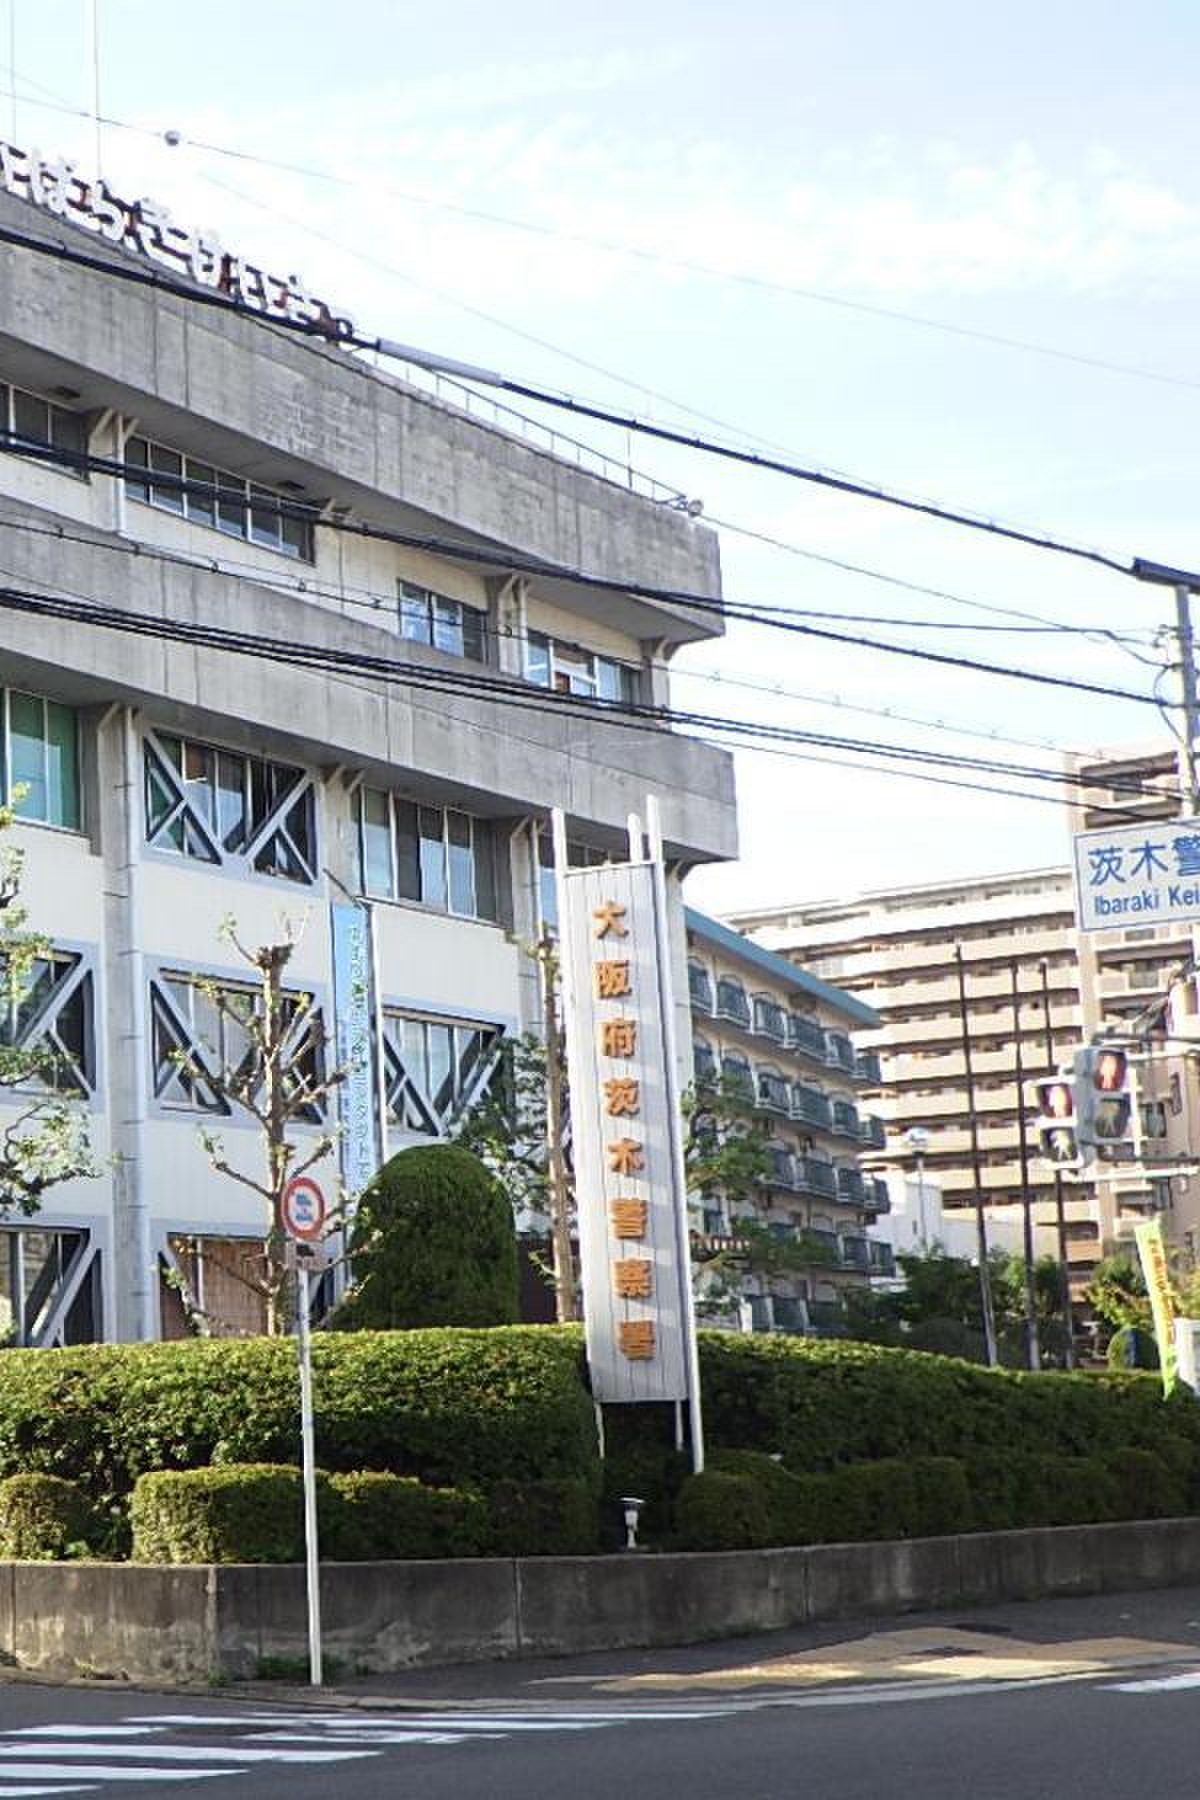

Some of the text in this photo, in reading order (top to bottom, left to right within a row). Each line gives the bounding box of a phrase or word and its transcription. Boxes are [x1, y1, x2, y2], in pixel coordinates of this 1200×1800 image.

[1095, 887, 1160, 916] Ibaraki
[592, 900, 656, 1361] 大阪府茨木警察署
